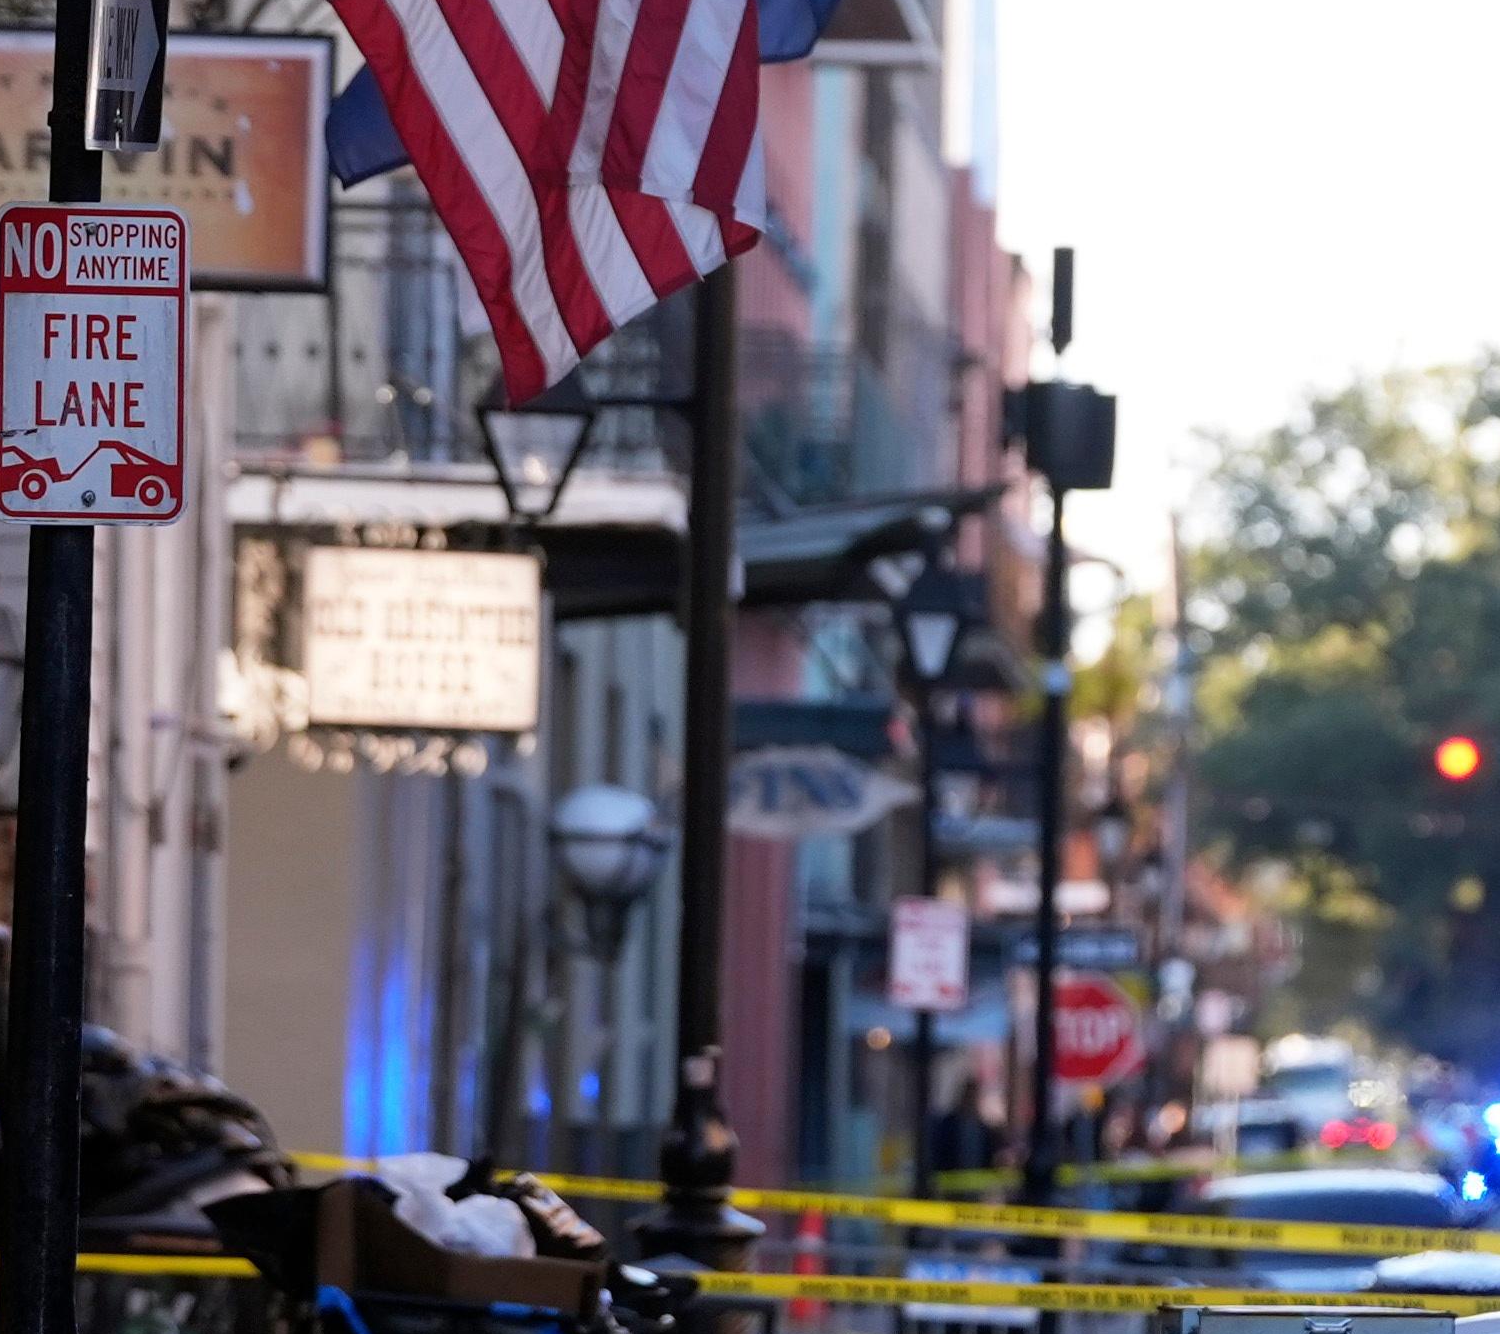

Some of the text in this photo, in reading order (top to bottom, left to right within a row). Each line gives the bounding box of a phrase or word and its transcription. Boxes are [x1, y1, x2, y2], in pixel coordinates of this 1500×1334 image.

[4, 222, 177, 279] NO STOPPING
[76, 255, 170, 281] ANYTIME
[44, 313, 138, 360] FIRE
[35, 380, 145, 428] LANE
[1056, 1006, 1131, 1057] TOP
